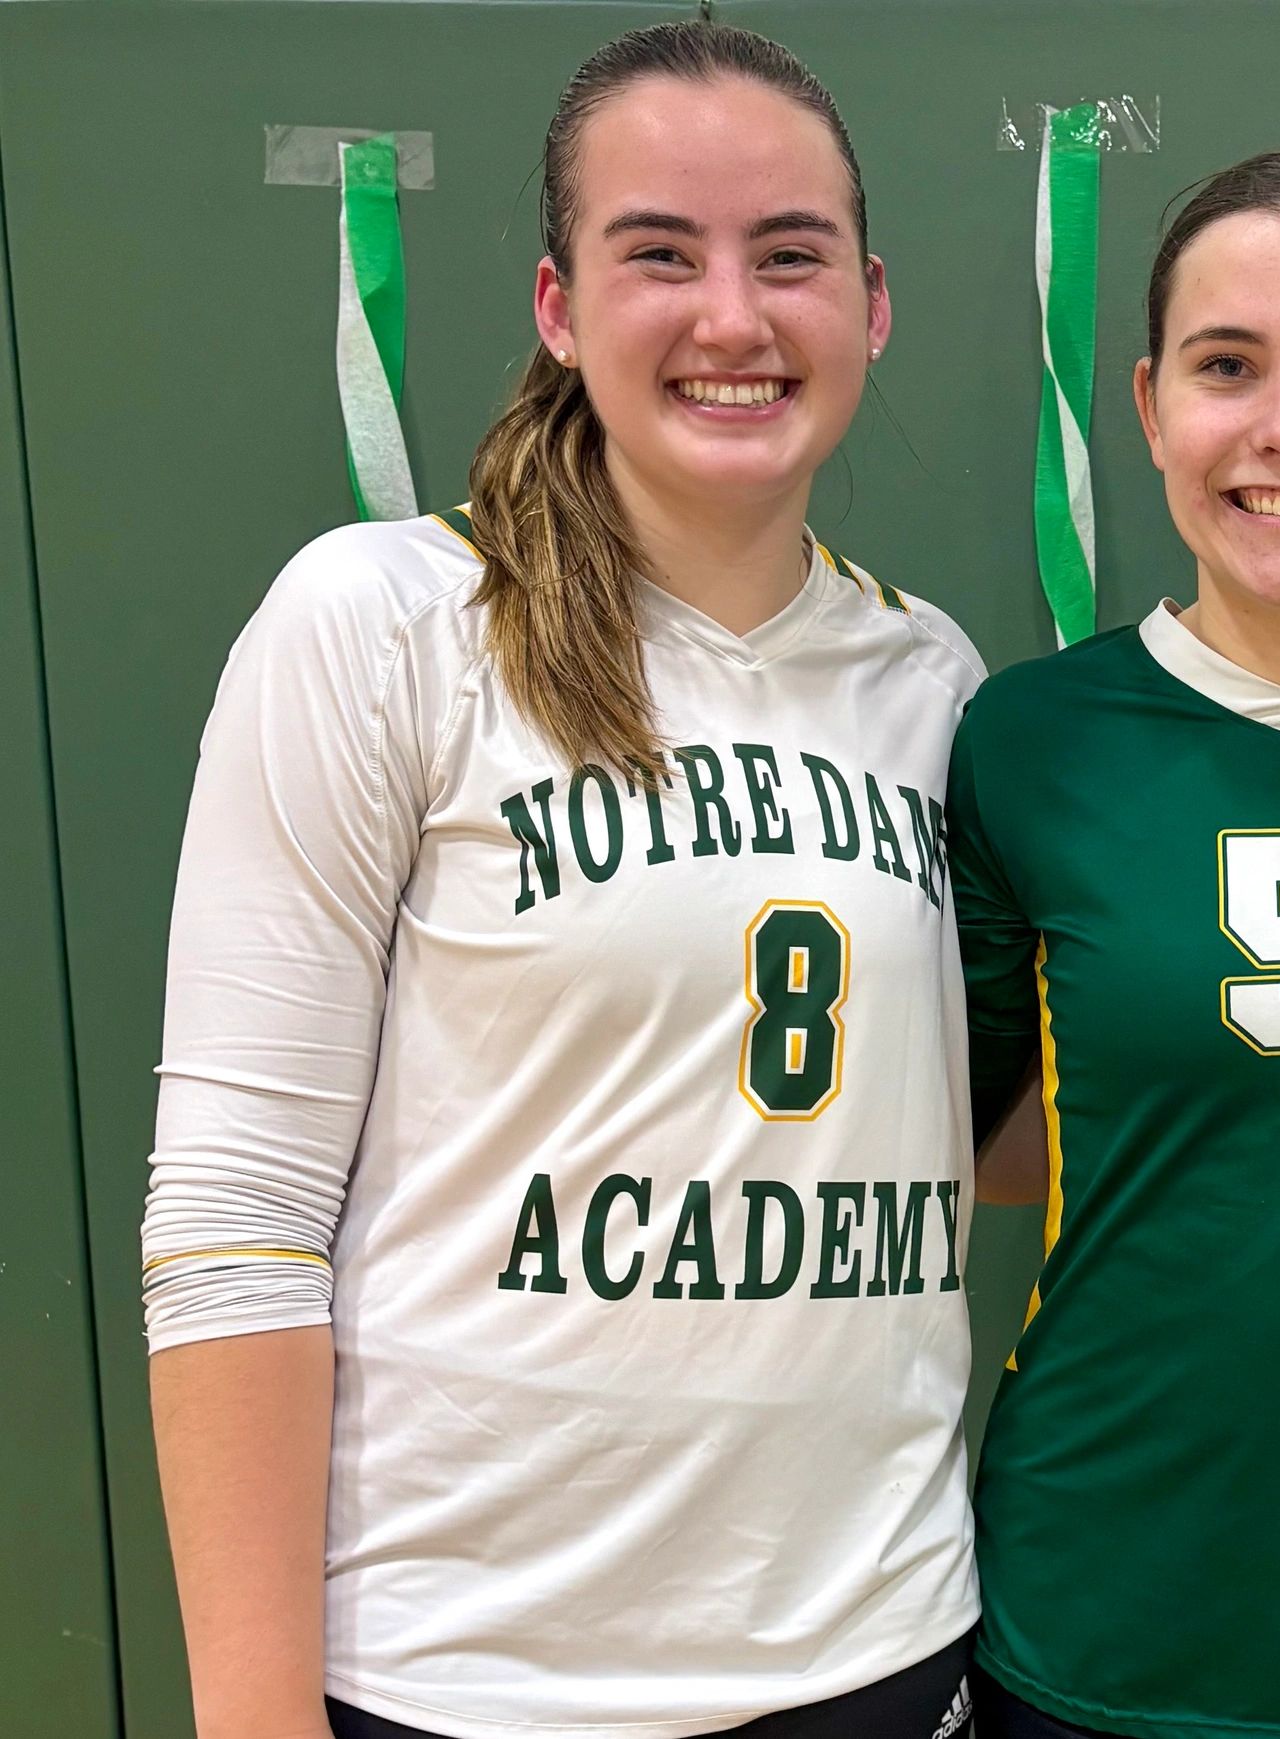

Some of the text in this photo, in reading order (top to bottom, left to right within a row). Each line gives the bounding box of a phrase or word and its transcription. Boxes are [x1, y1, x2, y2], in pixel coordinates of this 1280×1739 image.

[500, 743, 794, 915] NOTRE
[740, 899, 850, 1121] 8
[498, 1173, 960, 1301] ACADEMY
